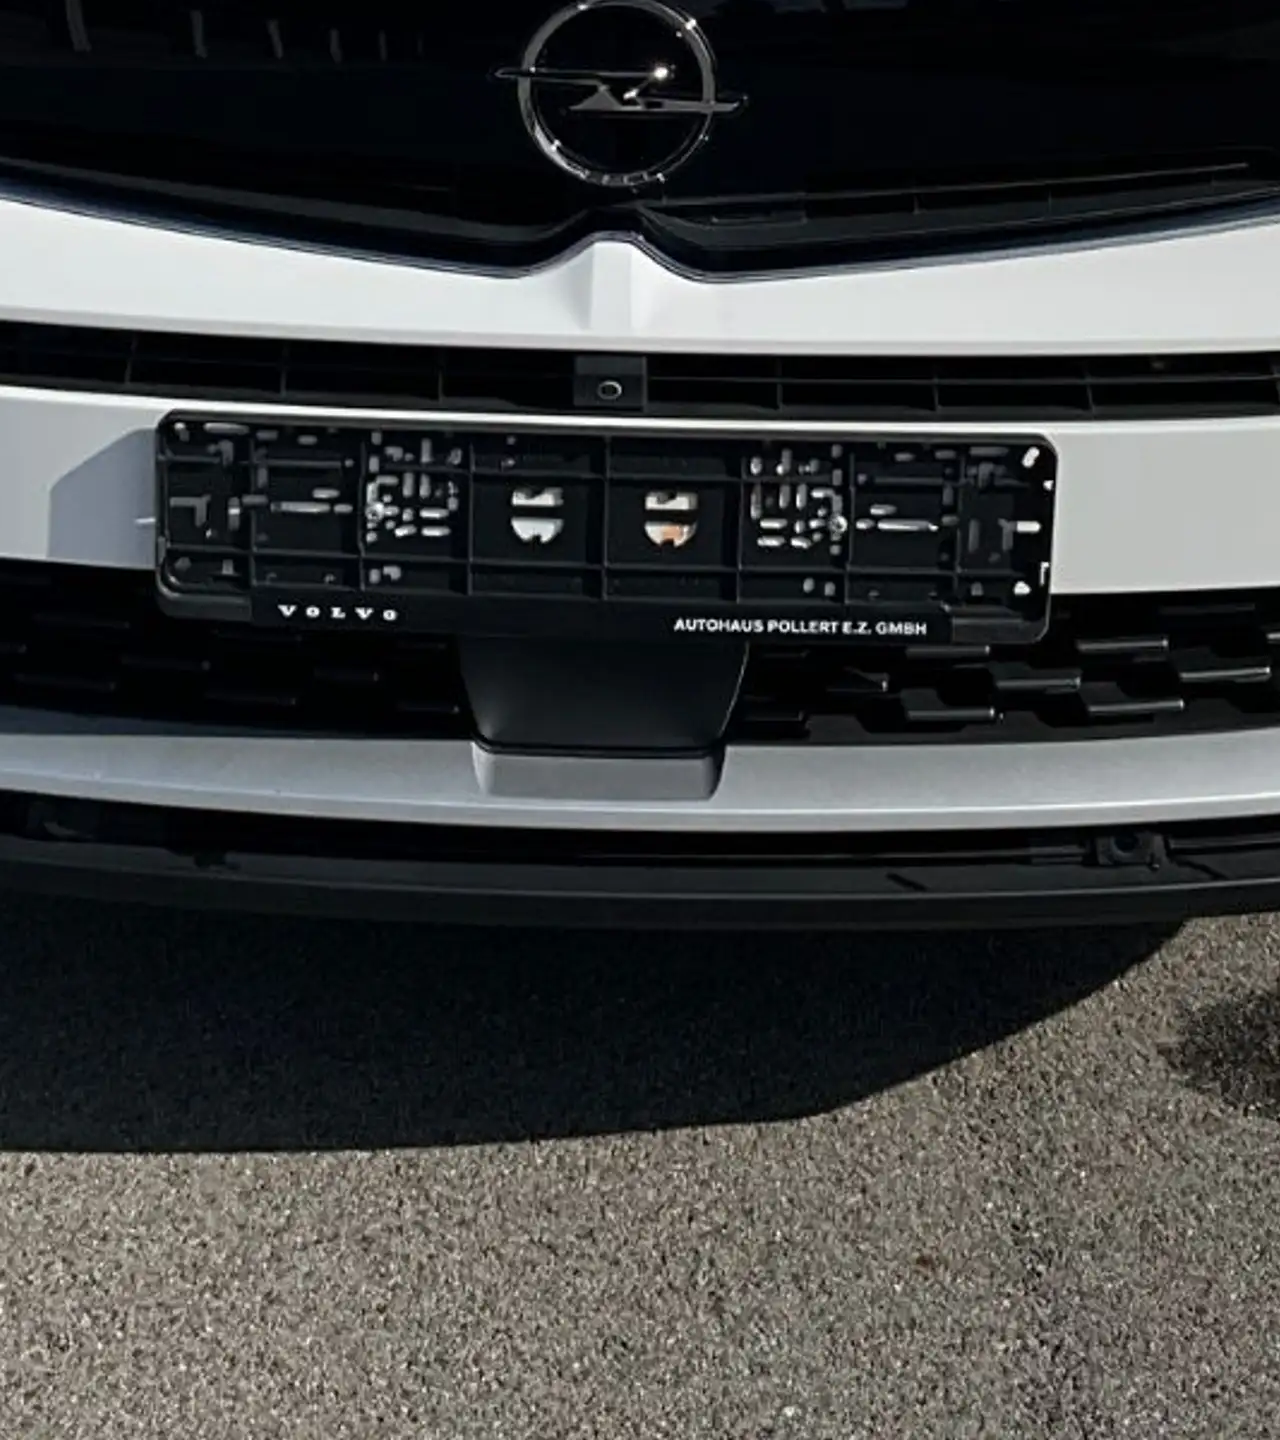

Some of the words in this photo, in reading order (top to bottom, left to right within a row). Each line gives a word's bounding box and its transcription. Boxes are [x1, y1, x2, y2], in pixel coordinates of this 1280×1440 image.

[277, 604, 398, 621] VOLVO
[673, 617, 764, 634] AUTOHAUS
[767, 619, 839, 635] POLLERT
[841, 620, 872, 636] E.Z.
[875, 620, 928, 637] GMBH
